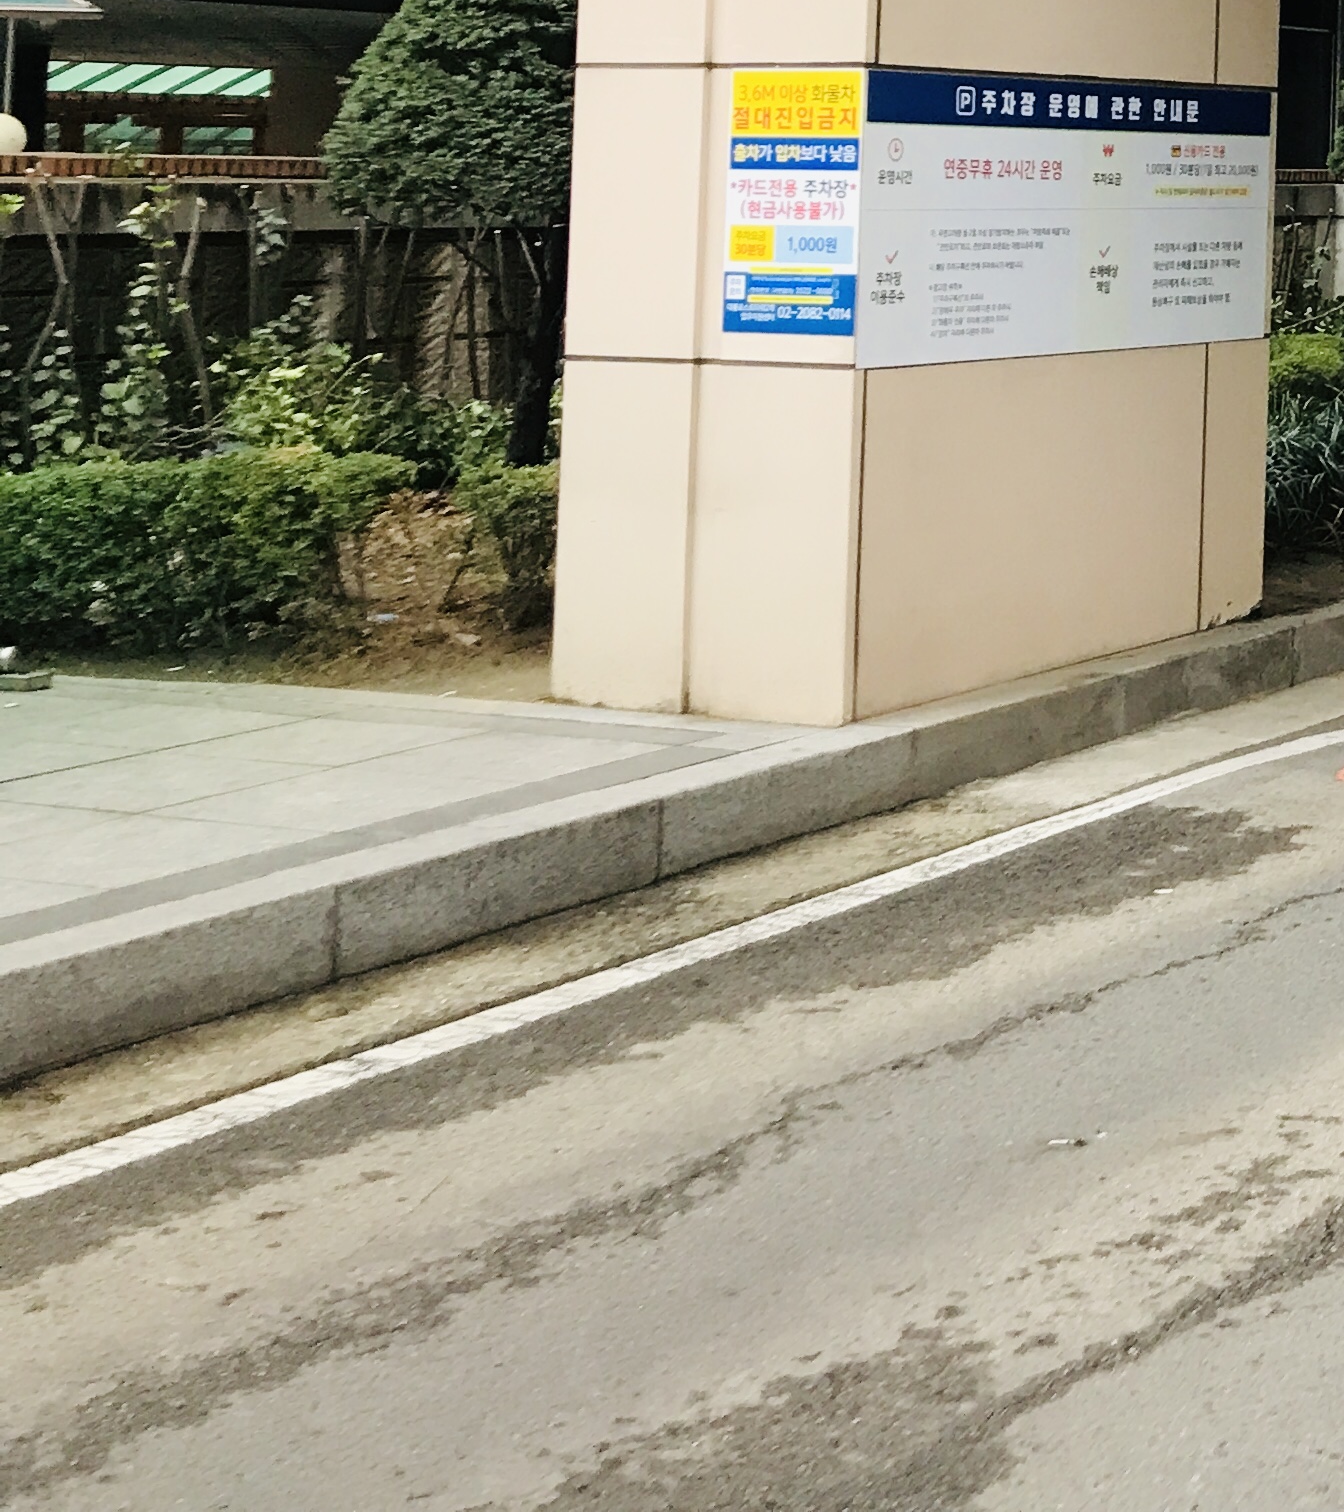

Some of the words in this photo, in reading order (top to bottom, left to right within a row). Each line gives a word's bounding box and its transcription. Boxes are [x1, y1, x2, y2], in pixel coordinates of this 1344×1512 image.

[779, 84, 808, 103] 이상
[811, 84, 856, 103] 화물차
[981, 90, 1036, 117] 주차장
[1111, 96, 1142, 121] 관한
[1153, 98, 1199, 123] 안내문
[733, 106, 857, 130] 절대진입금지
[829, 144, 857, 163] 낮음
[944, 158, 993, 180] 연중무휴
[997, 160, 1036, 180] 24시간
[1039, 160, 1063, 181] 운영
[740, 200, 845, 220] (현금사용불가)
[787, 236, 838, 254] 1,000원
